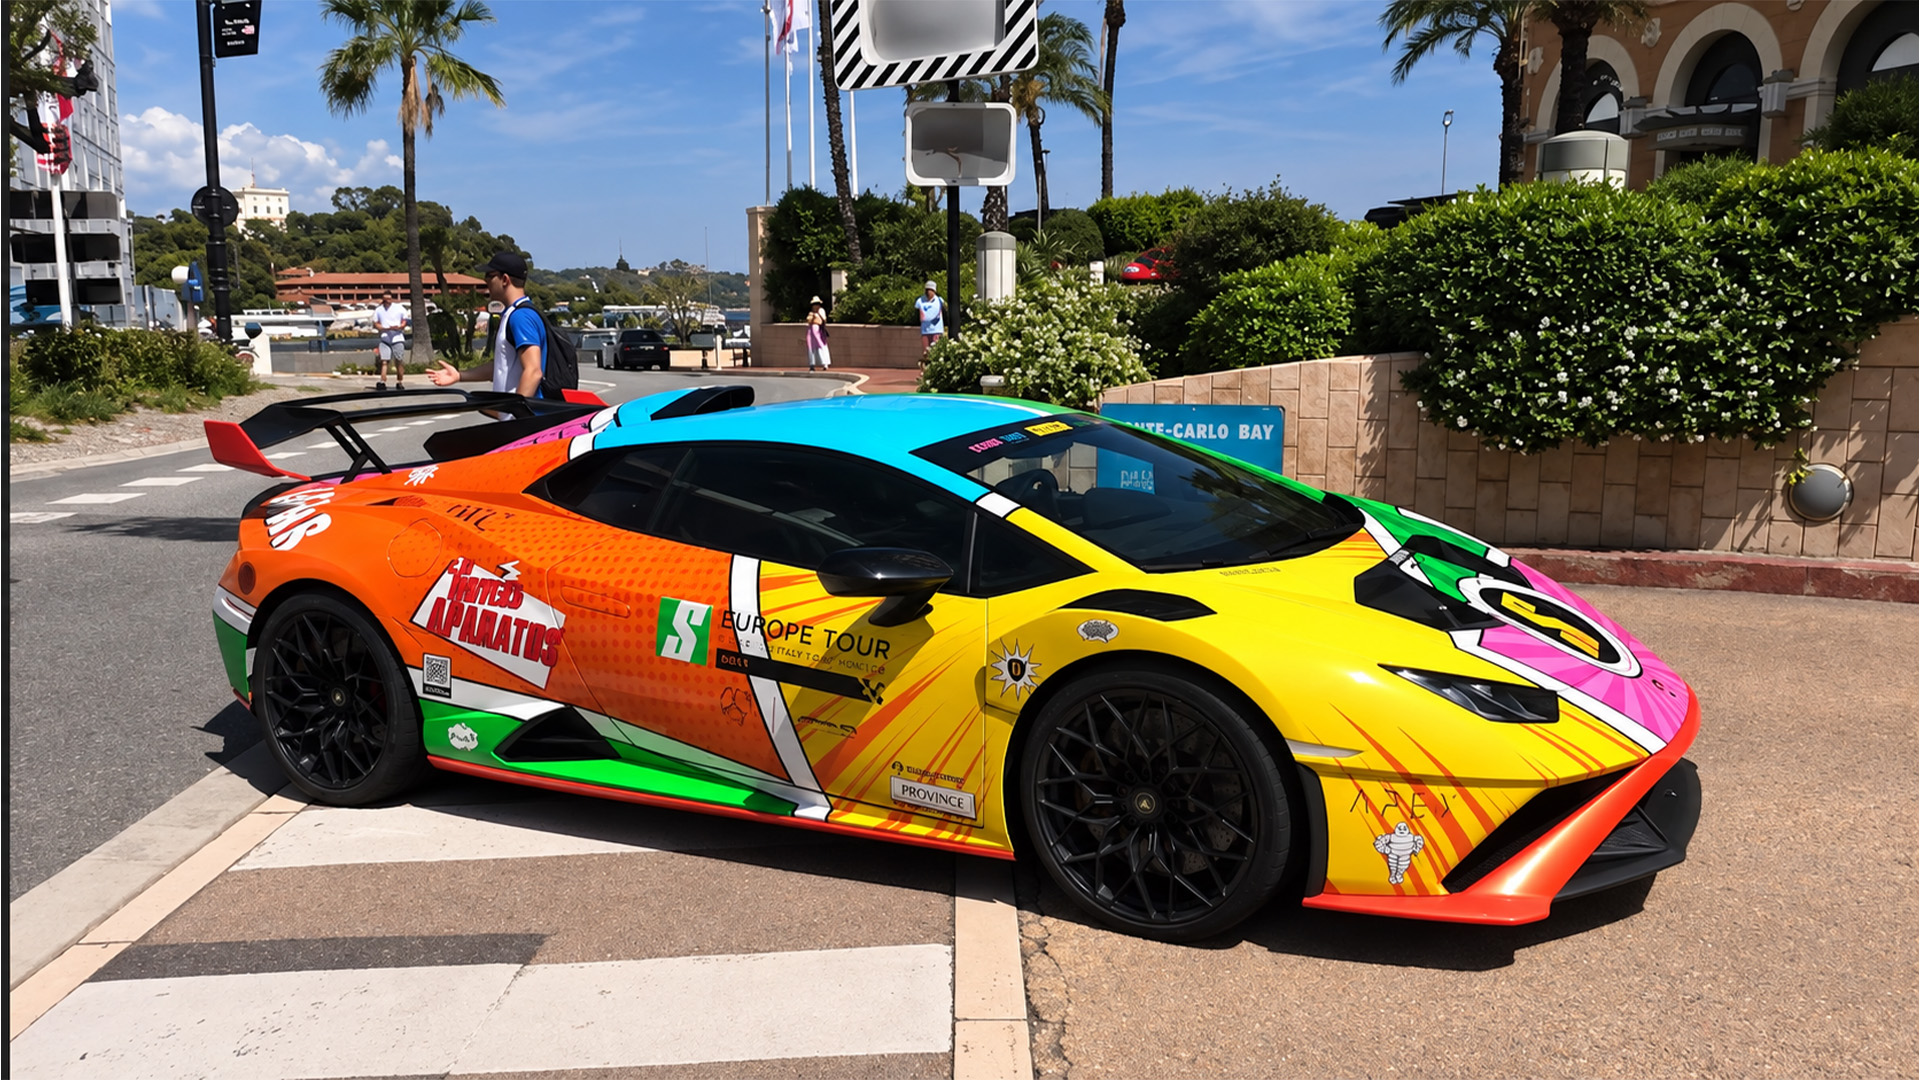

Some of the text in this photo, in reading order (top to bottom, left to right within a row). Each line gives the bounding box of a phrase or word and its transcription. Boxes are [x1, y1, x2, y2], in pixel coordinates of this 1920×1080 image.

[1125, 421, 1275, 440] TE-CARLO BAY
[660, 599, 713, 663] S
[721, 610, 815, 645] EUROPE
[824, 628, 892, 660] TOUR
[901, 784, 965, 809] PROVINCE
